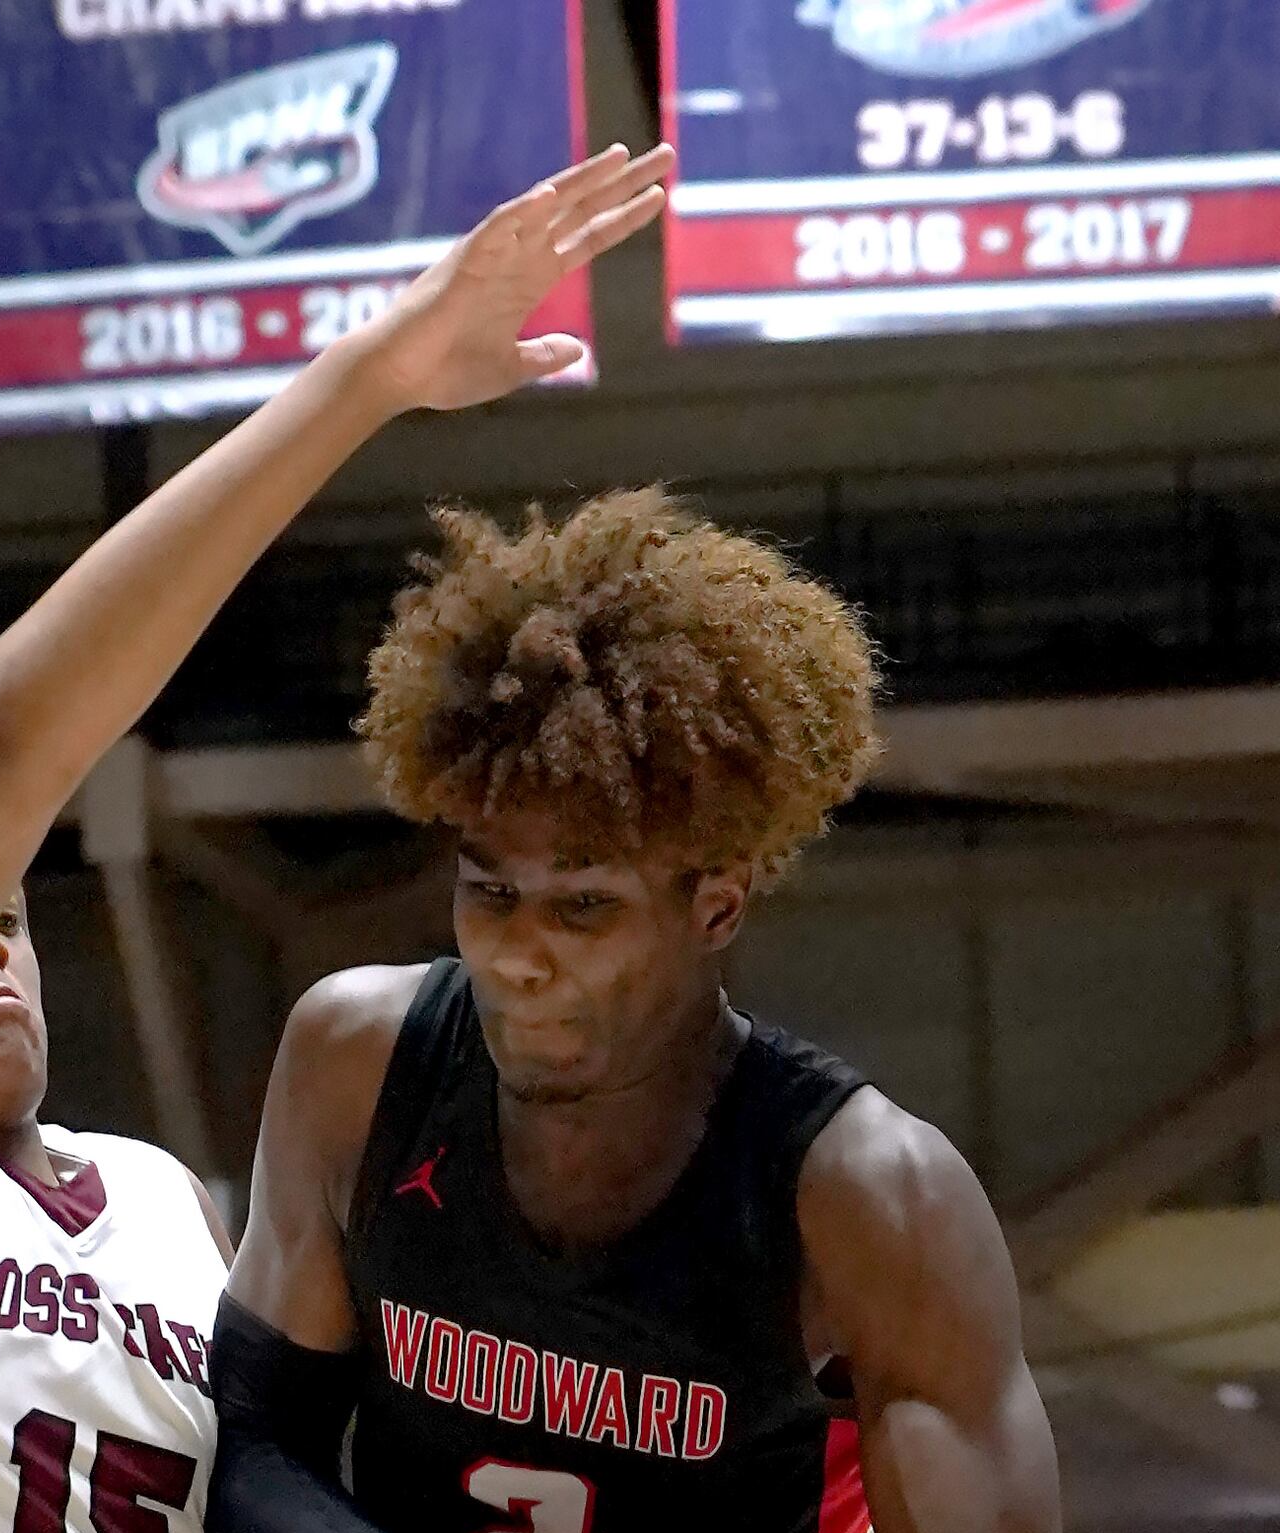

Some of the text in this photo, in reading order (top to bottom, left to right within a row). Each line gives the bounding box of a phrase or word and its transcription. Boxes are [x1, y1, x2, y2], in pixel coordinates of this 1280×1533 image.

[794, 198, 1193, 284] 2016 2017
[78, 297, 244, 371] 2016
[380, 1297, 728, 1461] WOODWARD
